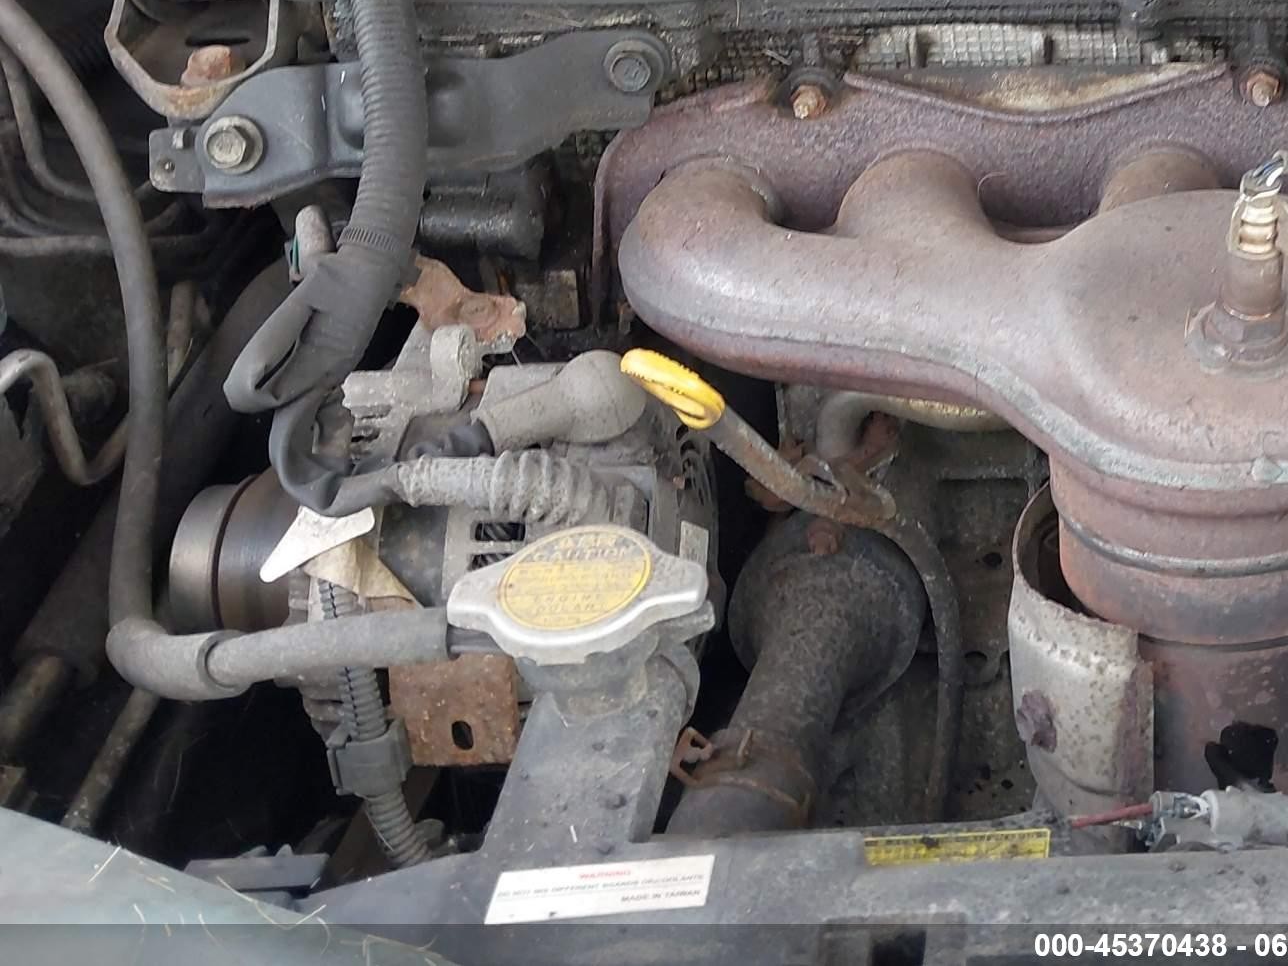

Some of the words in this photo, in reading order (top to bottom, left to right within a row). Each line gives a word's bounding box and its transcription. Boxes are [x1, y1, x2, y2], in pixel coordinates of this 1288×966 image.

[533, 545, 632, 562] CAUTION
[578, 869, 632, 880] WARNING
[620, 893, 648, 903] MADE
[651, 891, 662, 900] IN
[664, 889, 702, 899] TAIWAN
